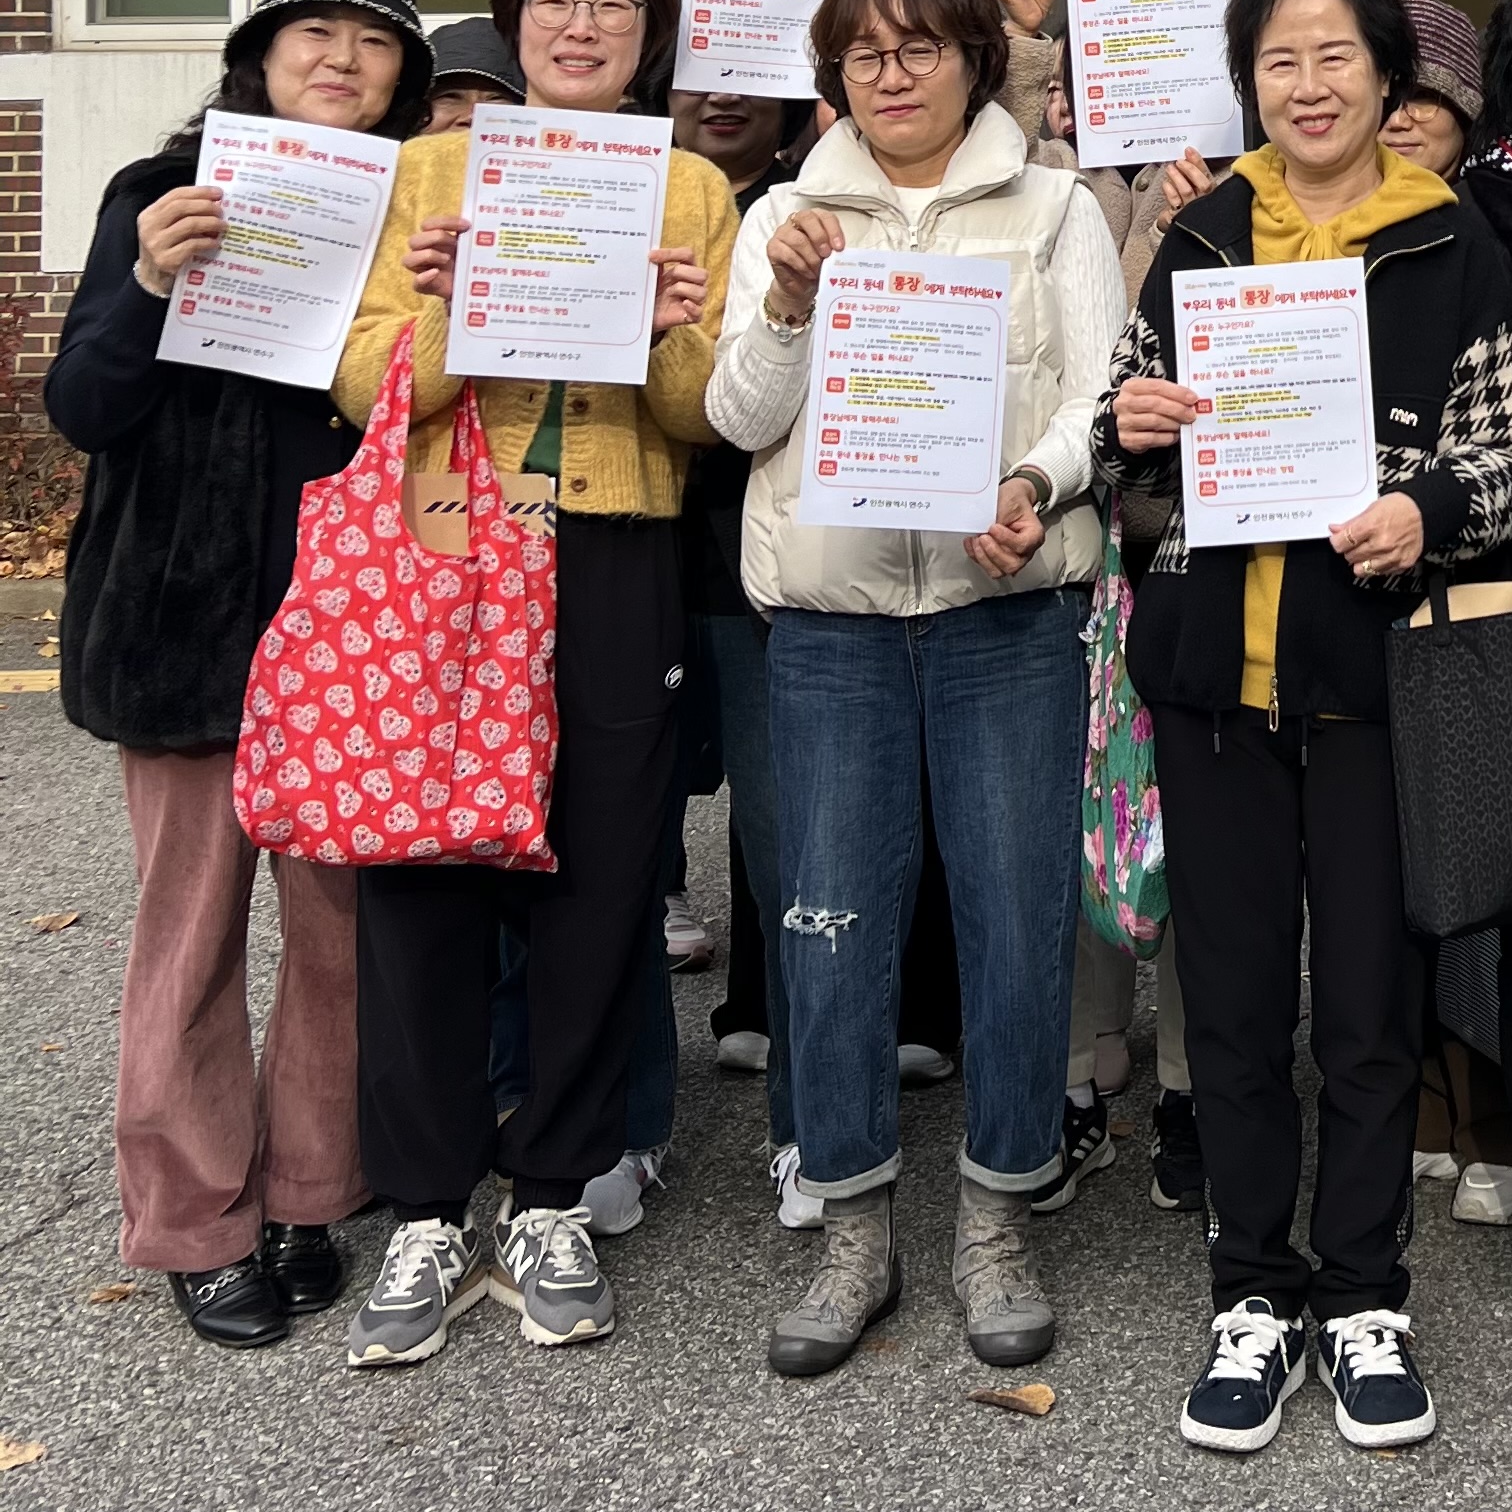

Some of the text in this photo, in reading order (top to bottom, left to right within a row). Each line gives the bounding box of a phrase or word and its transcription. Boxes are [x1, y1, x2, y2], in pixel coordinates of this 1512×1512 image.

[838, 277, 859, 288] 우리
[863, 279, 884, 290] 동네
[895, 276, 920, 292] 통장
[1192, 299, 1212, 311] 우리
[1215, 297, 1236, 311] 동네
[1245, 290, 1270, 305] 통장
[1274, 293, 1296, 304] 에게
